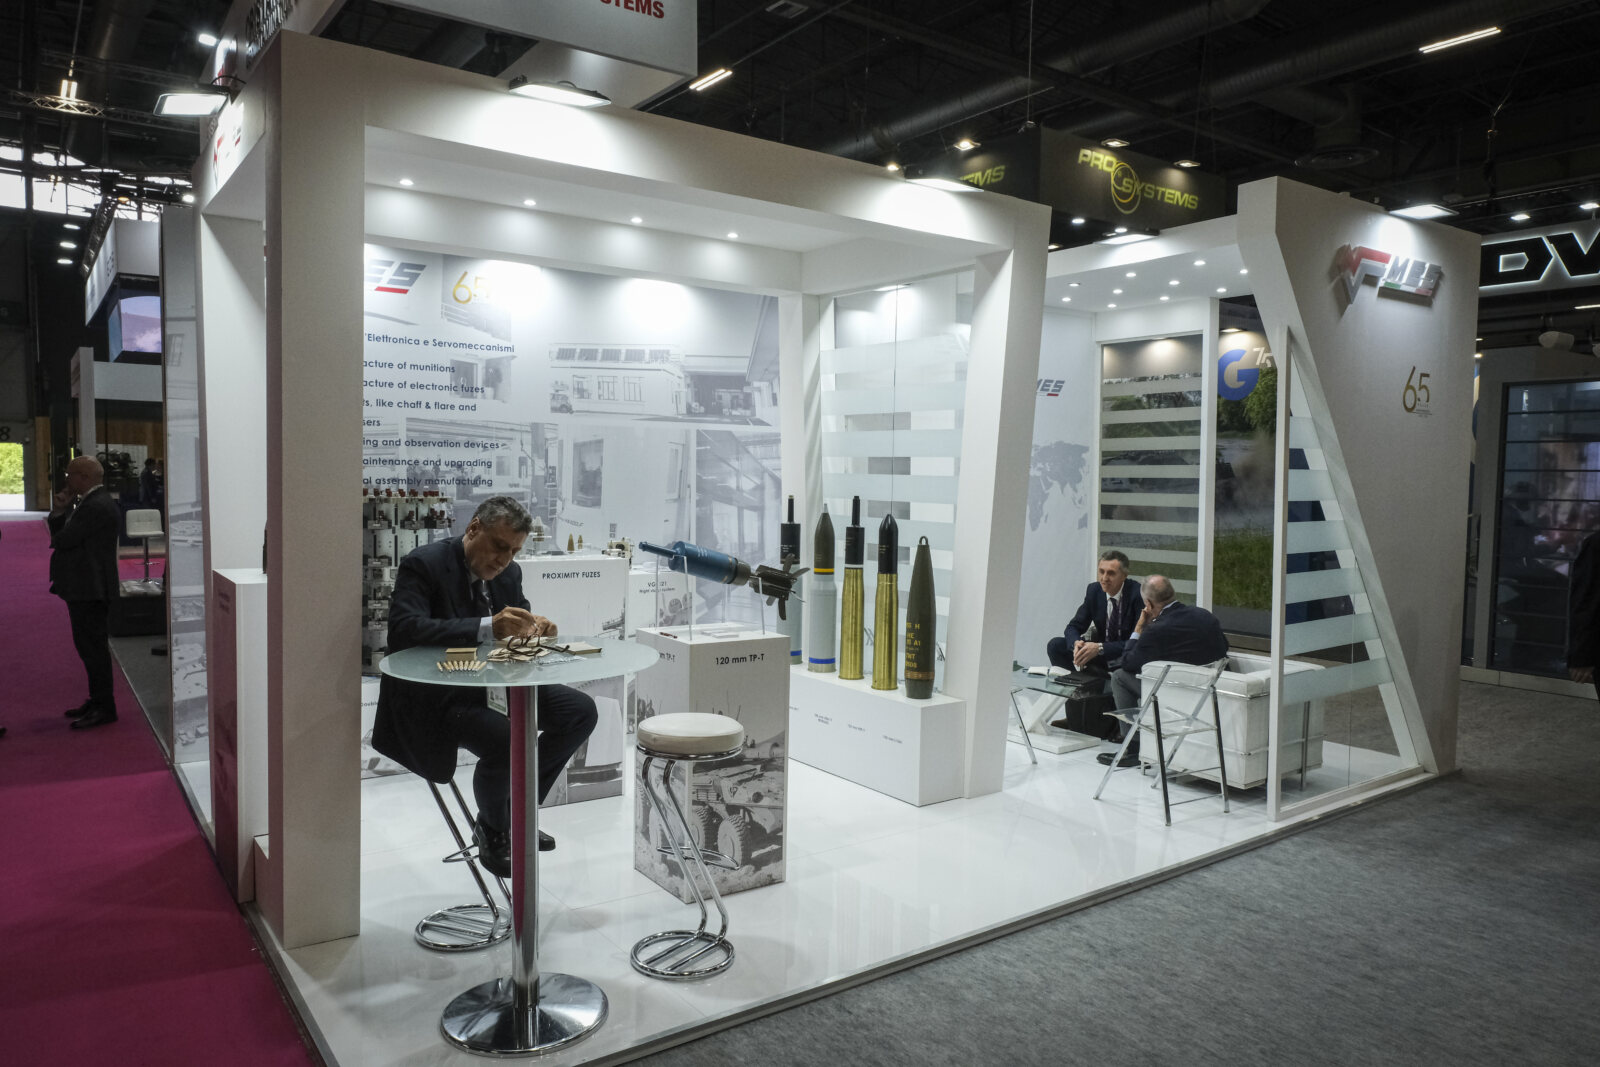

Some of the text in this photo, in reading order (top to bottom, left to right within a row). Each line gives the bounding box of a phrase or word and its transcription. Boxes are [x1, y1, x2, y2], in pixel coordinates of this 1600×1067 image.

[1078, 148, 1118, 173] PRO
[432, 338, 515, 353] Servomeccanismi
[397, 360, 407, 370] of
[409, 362, 456, 373] munitions
[397, 380, 407, 389] of
[410, 380, 459, 392] electronic
[461, 384, 485, 394] fuzes
[1403, 365, 1431, 413] 65
[376, 398, 394, 408] like
[397, 400, 422, 409] chaff
[425, 401, 431, 409] &
[434, 402, 456, 411] flare
[458, 403, 477, 412] and
[382, 438, 401, 447] and
[404, 439, 461, 449] observation
[463, 440, 500, 449] devices
[422, 457, 442, 466] and
[444, 458, 493, 469] upgrading
[375, 476, 422, 487] assembly
[424, 477, 493, 488] manufacturing
[542, 571, 580, 580] PROXIMITY
[715, 653, 765, 665] 120 mm TP-T
